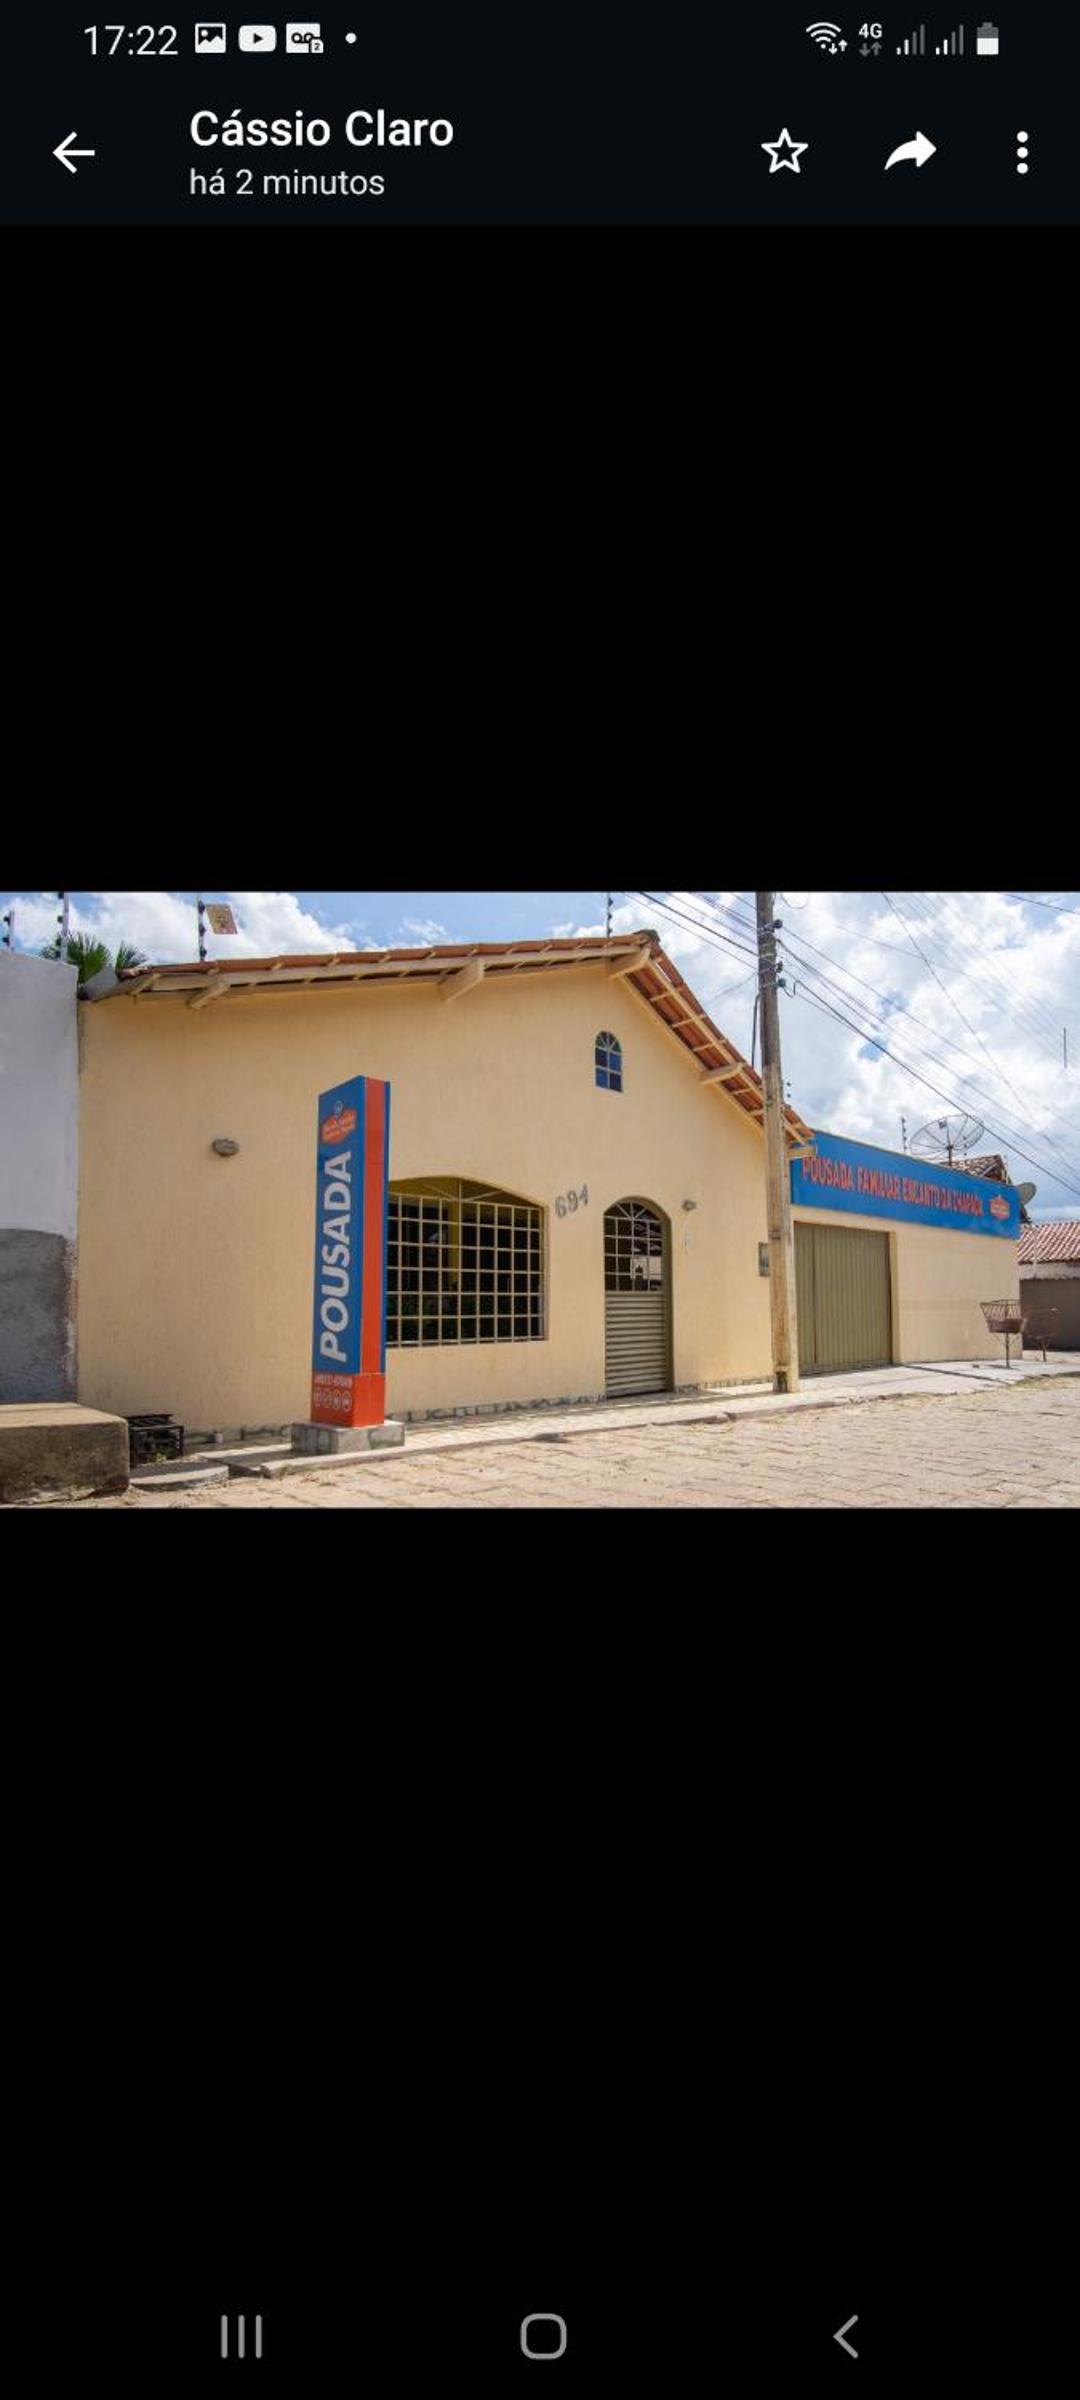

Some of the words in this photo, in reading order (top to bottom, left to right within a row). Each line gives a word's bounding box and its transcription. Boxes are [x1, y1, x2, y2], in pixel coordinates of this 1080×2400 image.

[802, 1154, 854, 1191] POUSADA
[857, 1167, 899, 1200] FAMILIAR
[903, 1177, 940, 1208] ENCANTO
[320, 1151, 353, 1362] POUSADA
